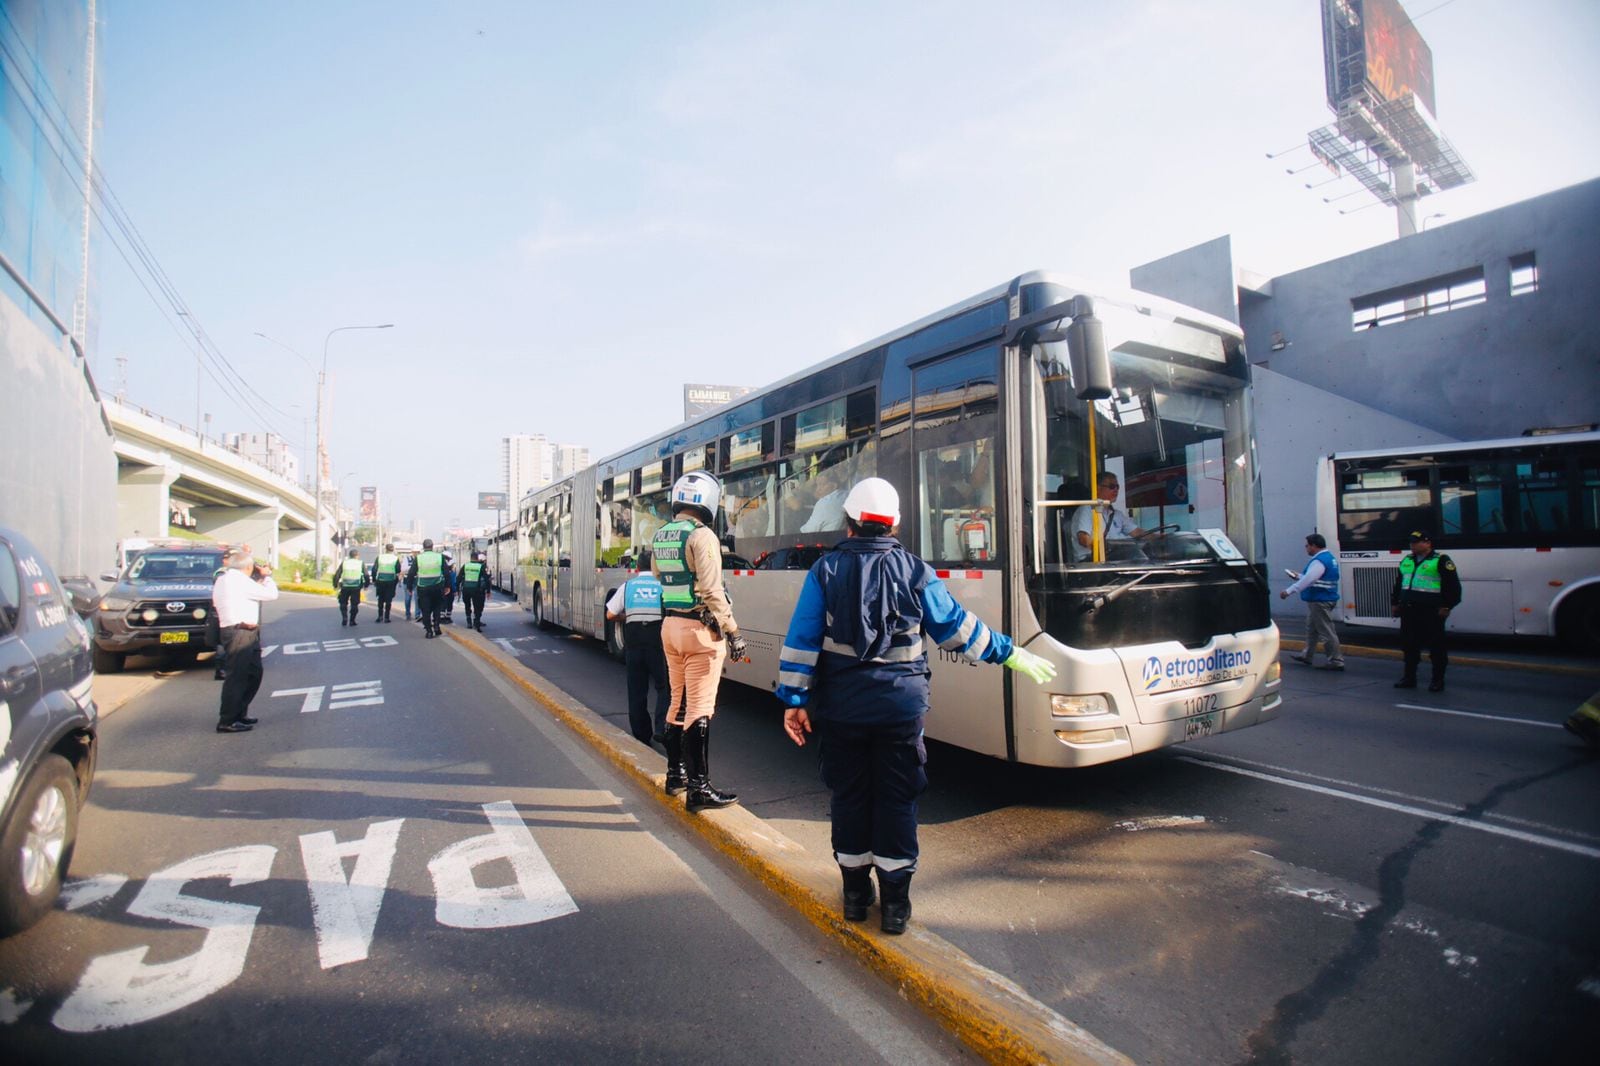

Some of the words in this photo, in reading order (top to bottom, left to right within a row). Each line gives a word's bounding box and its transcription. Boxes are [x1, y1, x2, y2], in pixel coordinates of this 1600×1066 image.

[20, 557, 43, 576] 105
[269, 679, 385, 713] EL
[1184, 694, 1217, 715] 11072
[0, 800, 581, 1034] PAS
